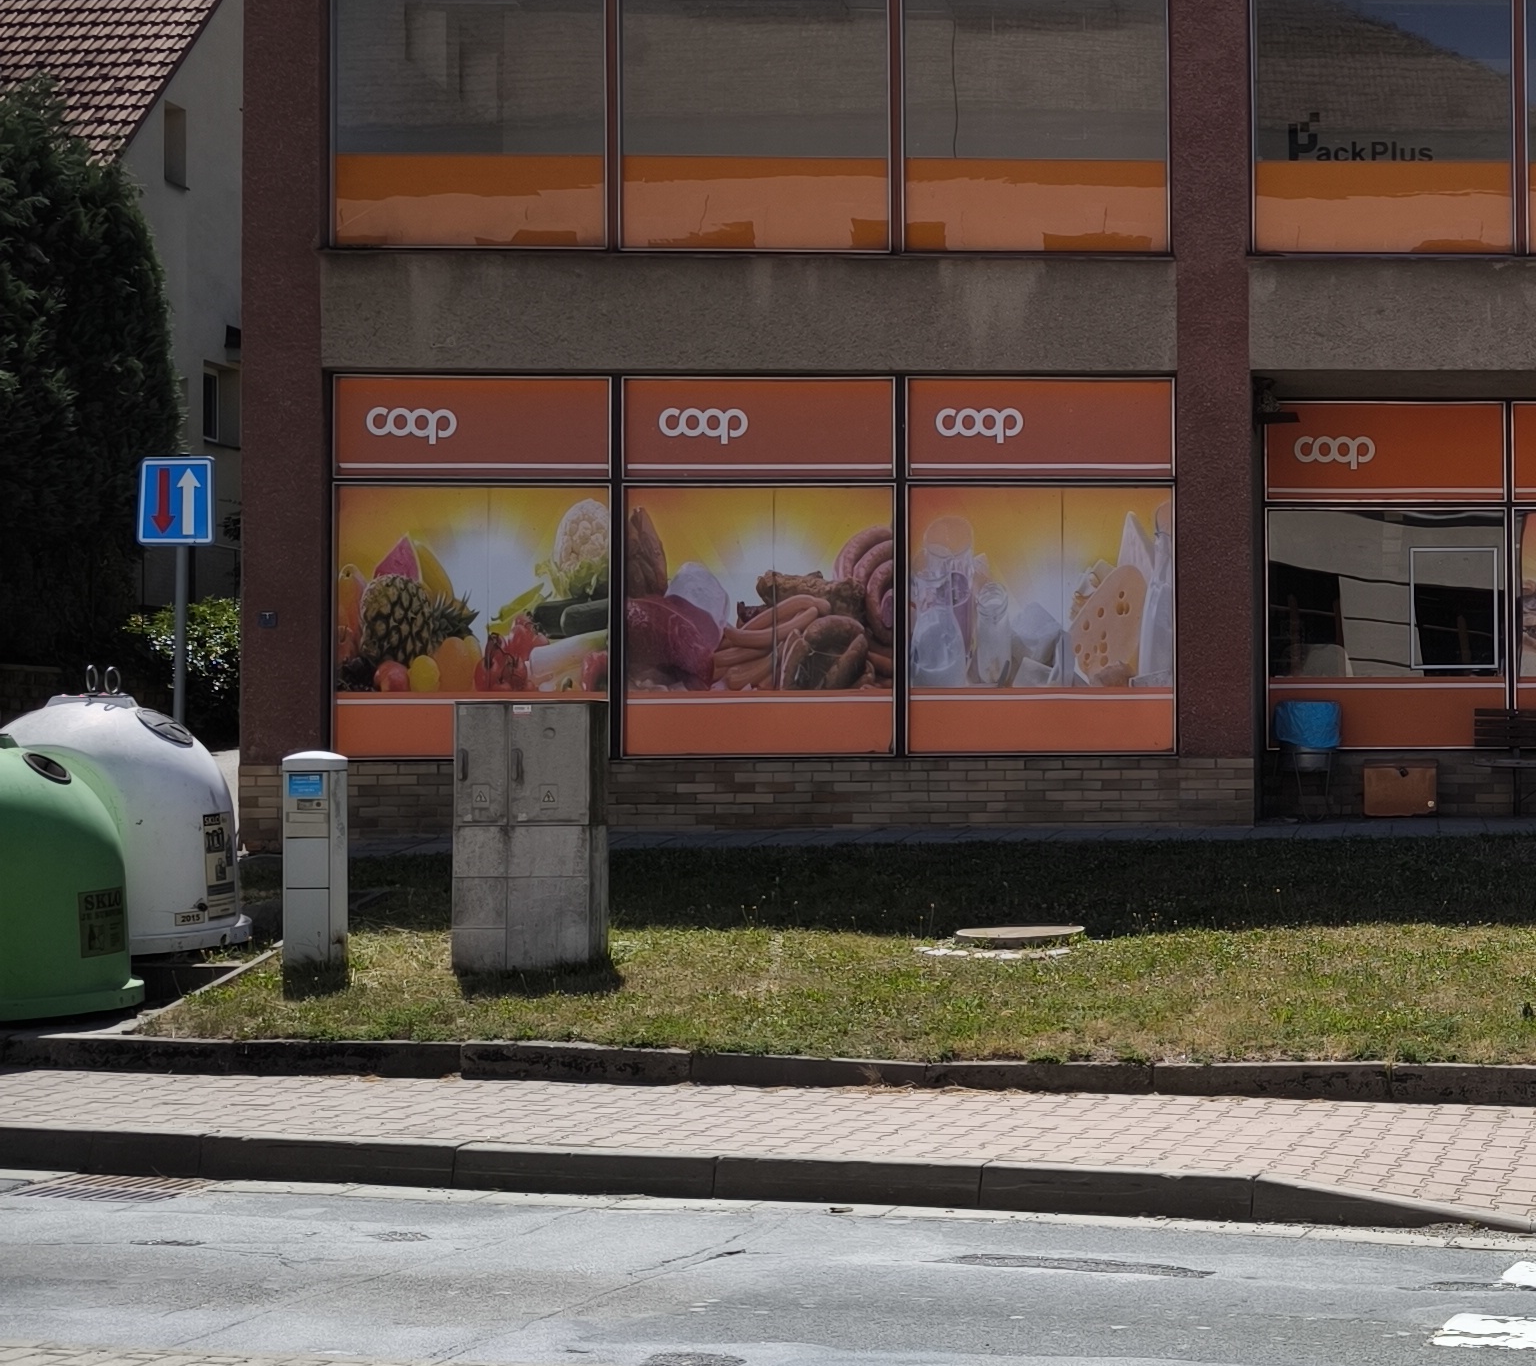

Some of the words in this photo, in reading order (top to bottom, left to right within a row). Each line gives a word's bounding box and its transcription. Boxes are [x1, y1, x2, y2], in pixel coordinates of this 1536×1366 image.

[366, 406, 458, 445] coop
[658, 407, 749, 445] coop
[935, 407, 1024, 444] coop
[1294, 435, 1376, 470] coop
[84, 890, 122, 911] SKLO
[181, 914, 201, 923] 2015
